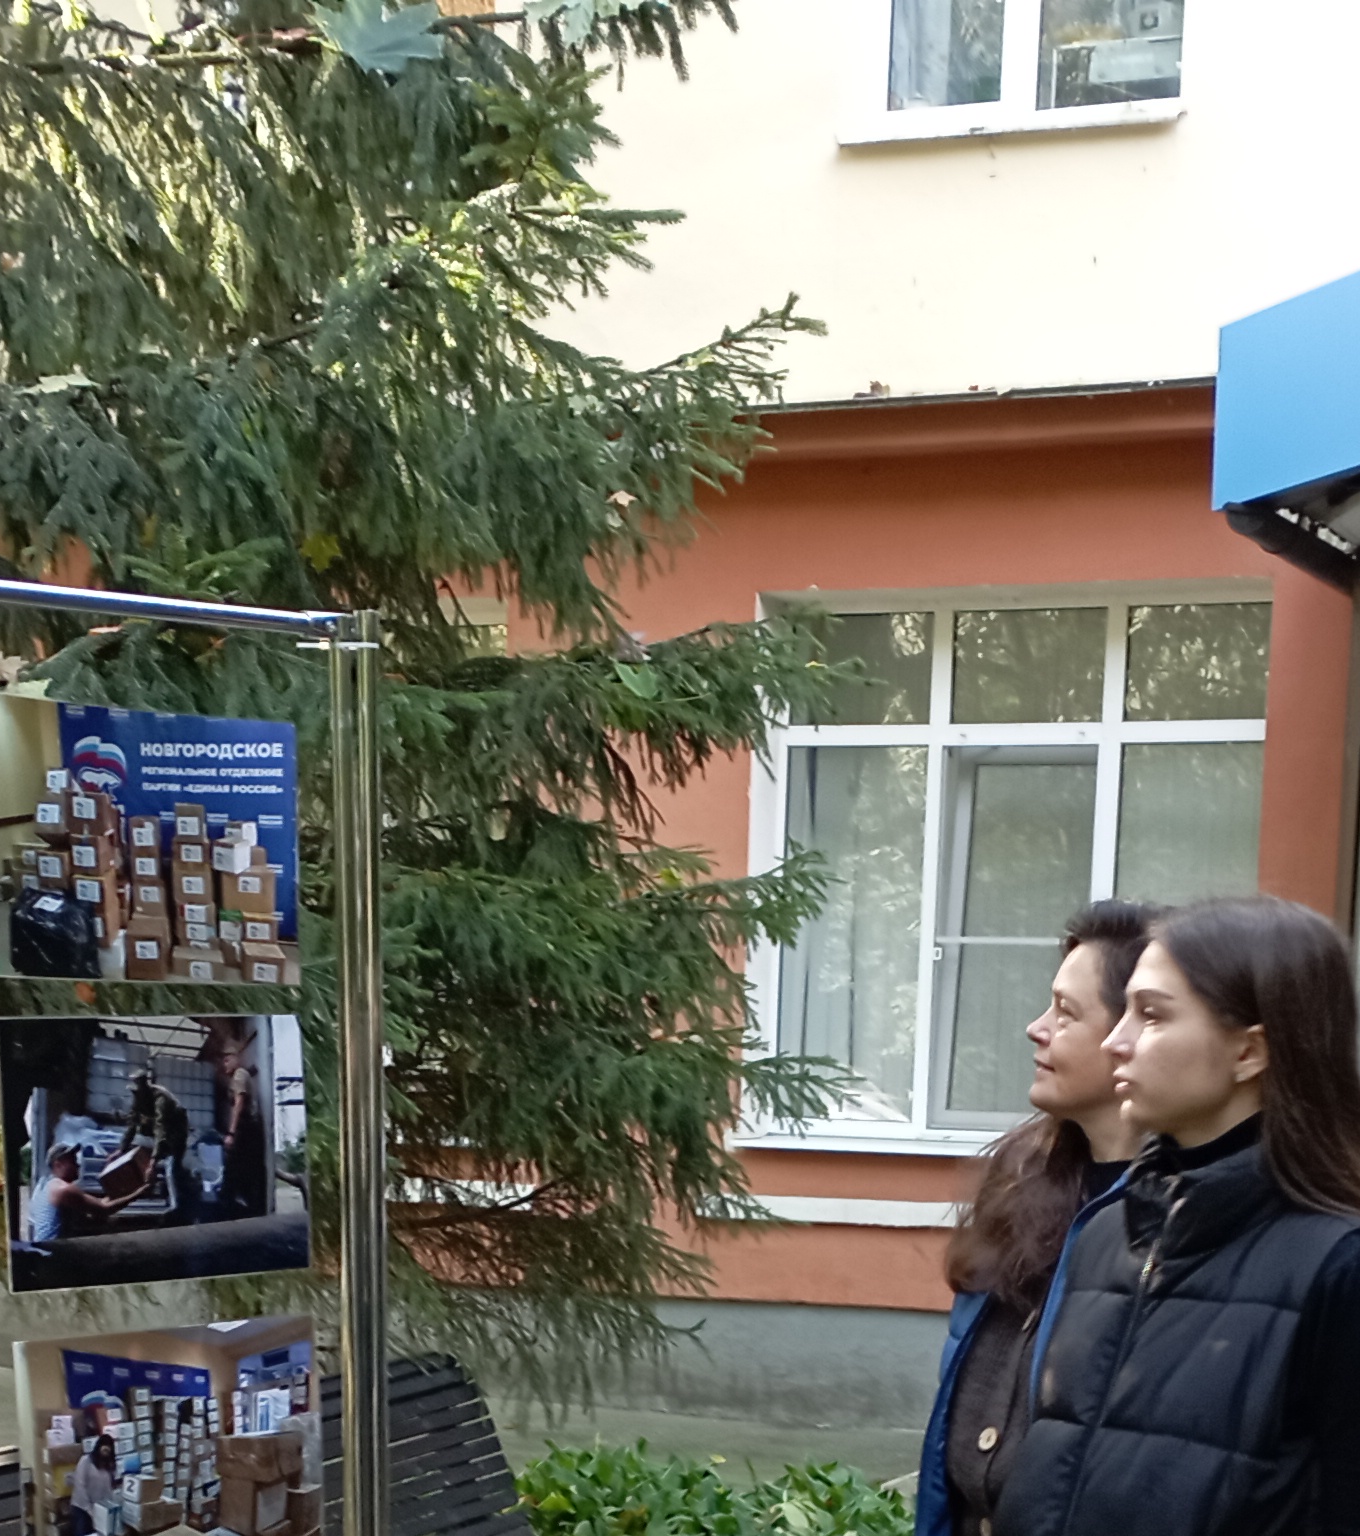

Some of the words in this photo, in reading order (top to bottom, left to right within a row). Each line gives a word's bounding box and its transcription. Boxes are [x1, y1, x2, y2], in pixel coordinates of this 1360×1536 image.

[140, 742, 284, 760] НОВГОРОДСКОЕ
[141, 765, 218, 778] РЕГИОНАЛЬНОЕ
[219, 767, 284, 778] ОТДЕЛЕНИЕ
[142, 782, 182, 792] ПАРТИИ
[126, 1479, 136, 1493] 2
